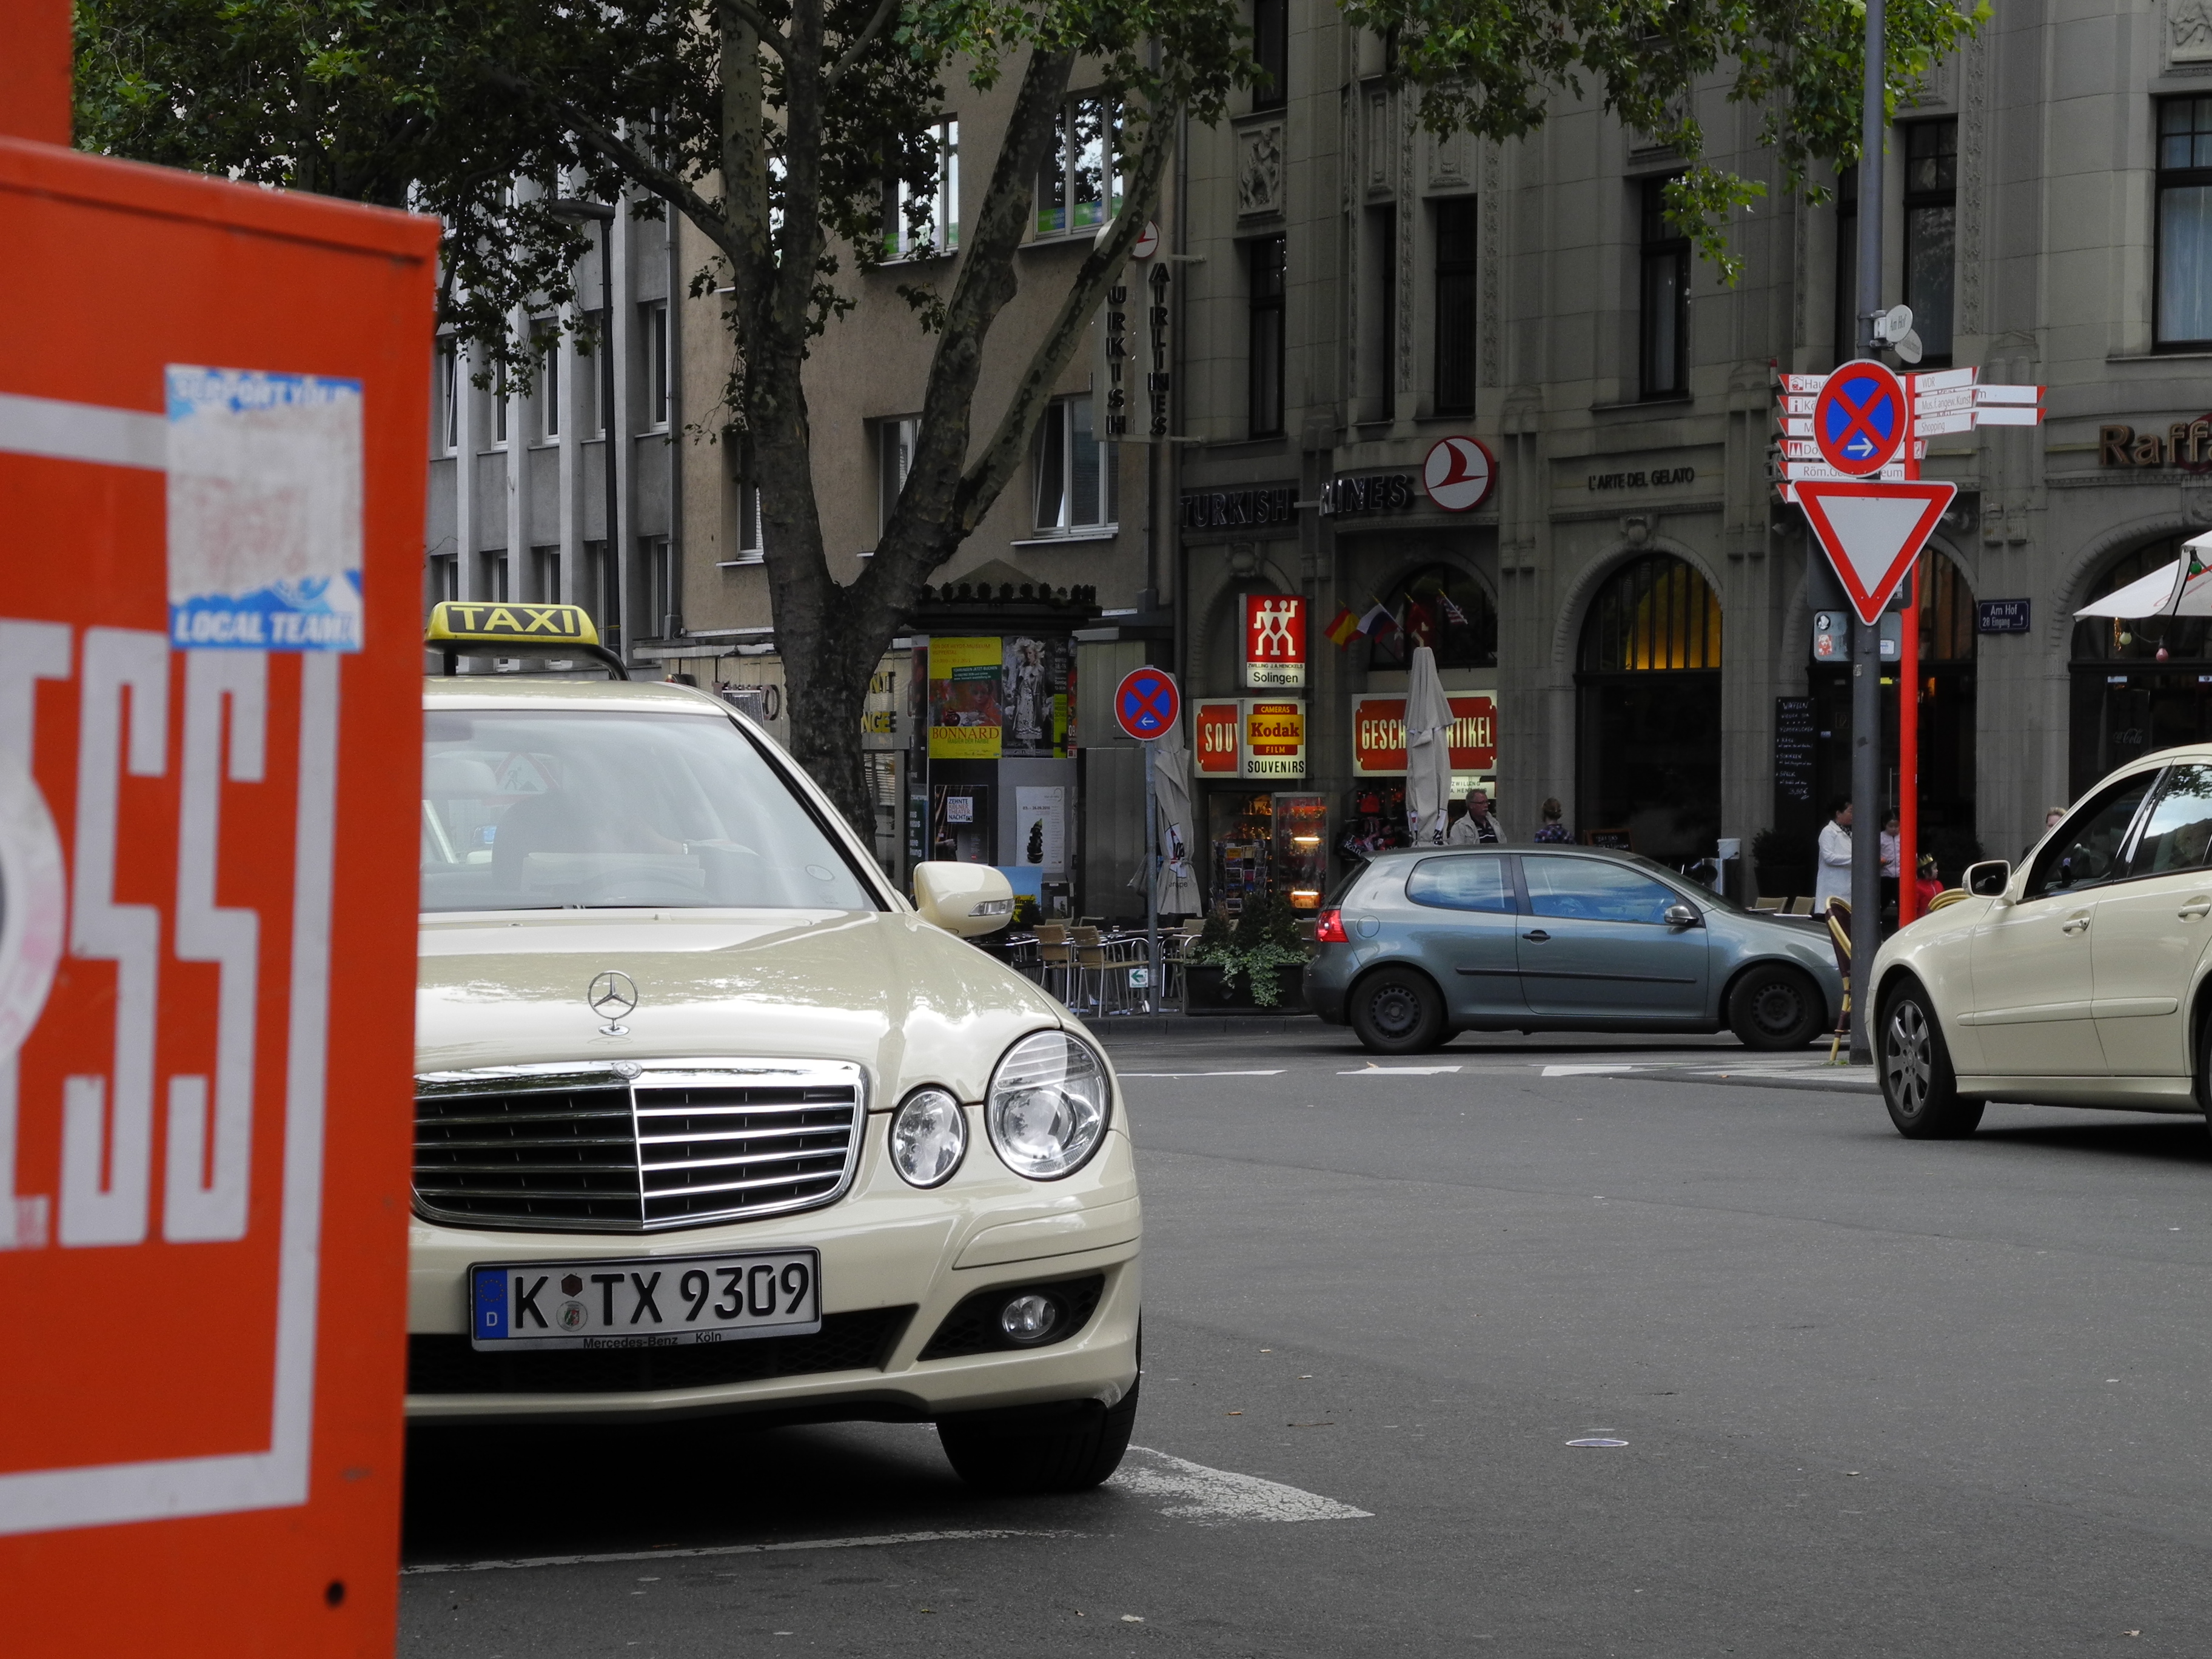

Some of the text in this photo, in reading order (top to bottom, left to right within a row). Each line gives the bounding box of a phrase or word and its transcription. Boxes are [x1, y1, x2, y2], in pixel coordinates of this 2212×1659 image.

[1106, 263, 1170, 435] URKISH AIRLINES
[1922, 377, 1936, 389] WDR
[1921, 422, 1945, 434] Shopping
[2099, 420, 2212, 466] Raff
[1627, 472, 1649, 488] DEL
[1651, 467, 1695, 486] GELATO
[1179, 488, 1288, 528] TURKISH
[1991, 603, 2017, 615] Am Hof
[175, 609, 266, 643] LOCAL
[451, 606, 574, 634] TAXI
[1983, 617, 2010, 629] 28 Eingang
[1253, 672, 1298, 685] Solingen
[933, 727, 999, 739] BONNARD
[1251, 722, 1300, 737] Kodak
[1248, 760, 1304, 773] SOUVENIRS
[1344, 840, 1362, 856] Köln
[515, 1262, 809, 1329] K TX 9309
[486, 1312, 498, 1327] D
[583, 1331, 722, 1350] Mercedes-Benz Köln
